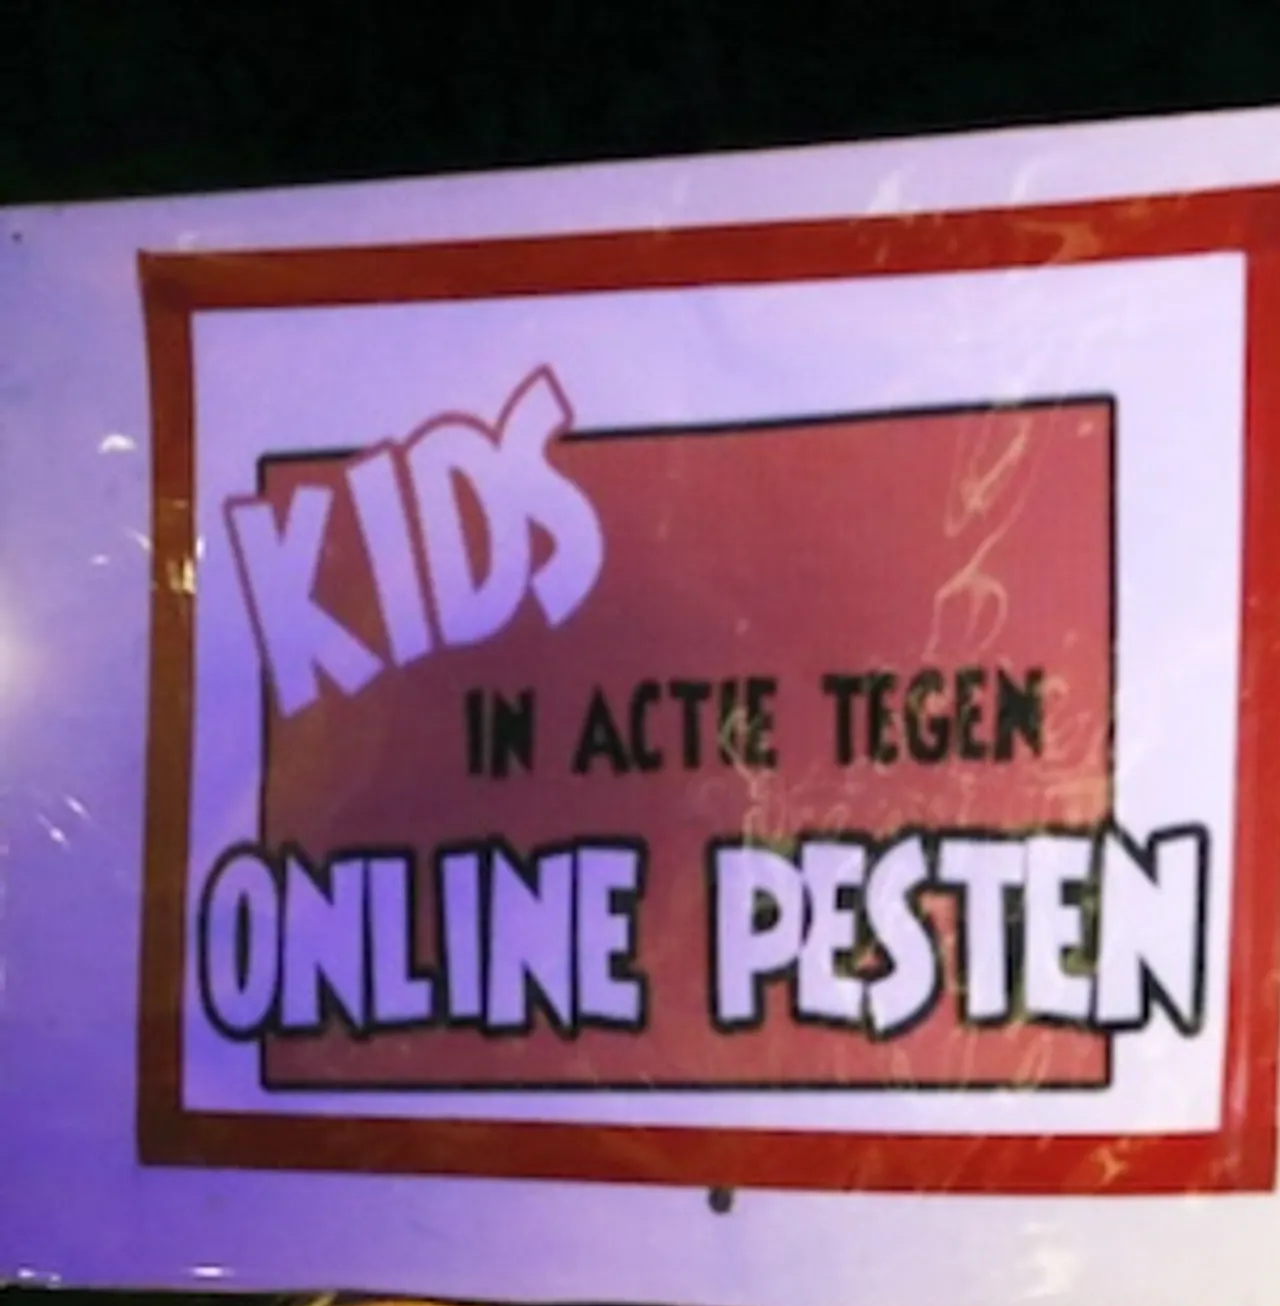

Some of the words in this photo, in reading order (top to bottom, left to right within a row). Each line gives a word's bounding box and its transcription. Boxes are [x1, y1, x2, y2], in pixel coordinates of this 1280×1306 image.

[222, 364, 606, 718] KIDS
[463, 685, 536, 779] IN
[571, 675, 778, 775] ACTIE
[820, 666, 1046, 767] TEGEN
[198, 837, 648, 1041] ONLINE
[706, 820, 1211, 1038] PESTEN
